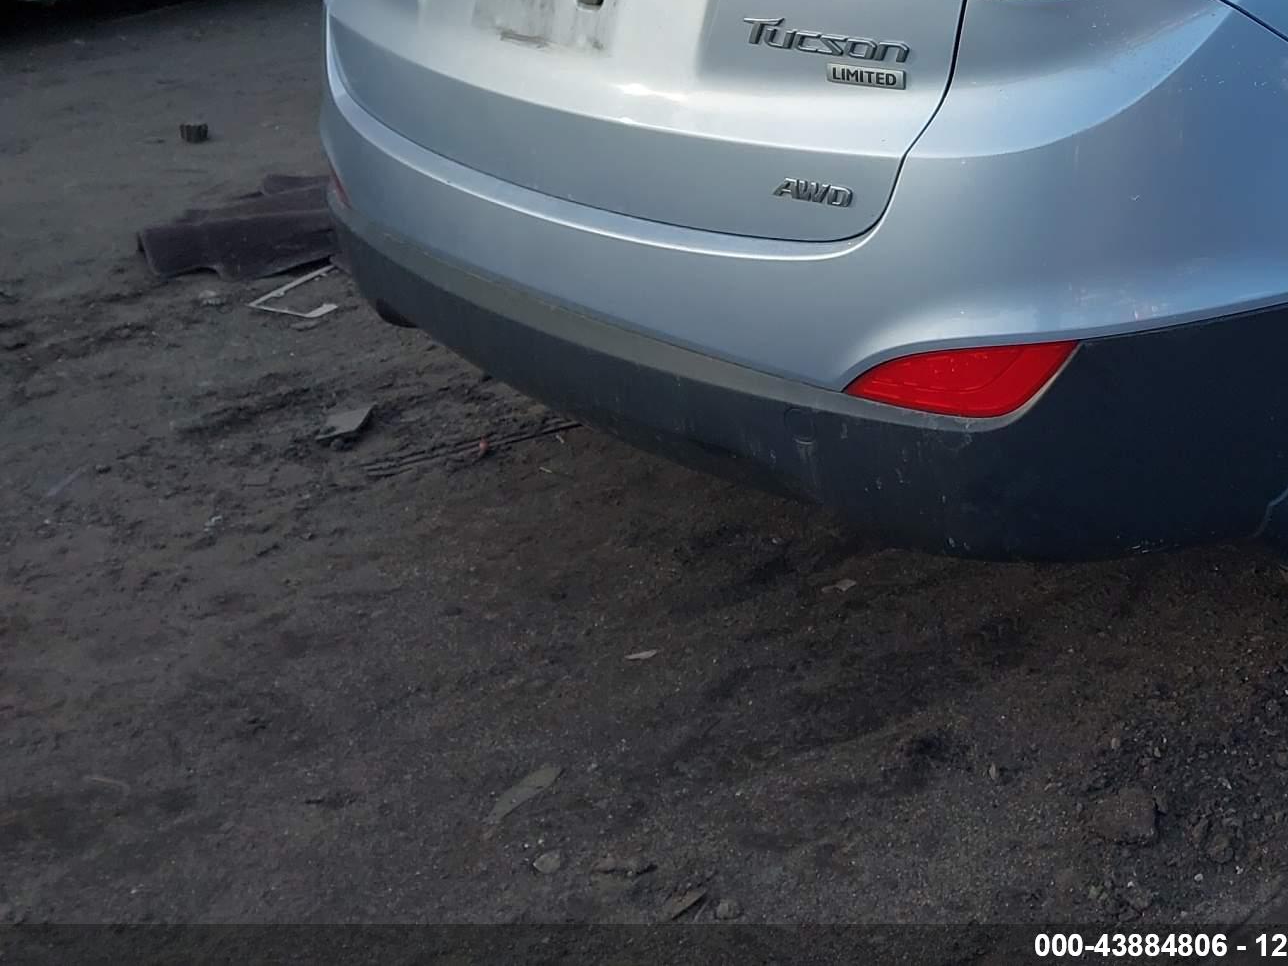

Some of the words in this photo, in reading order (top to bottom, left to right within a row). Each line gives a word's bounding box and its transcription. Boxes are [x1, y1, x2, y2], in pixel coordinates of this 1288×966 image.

[743, 17, 910, 64] Tucson
[832, 67, 897, 86] LIMITED
[773, 177, 854, 208] AWD
